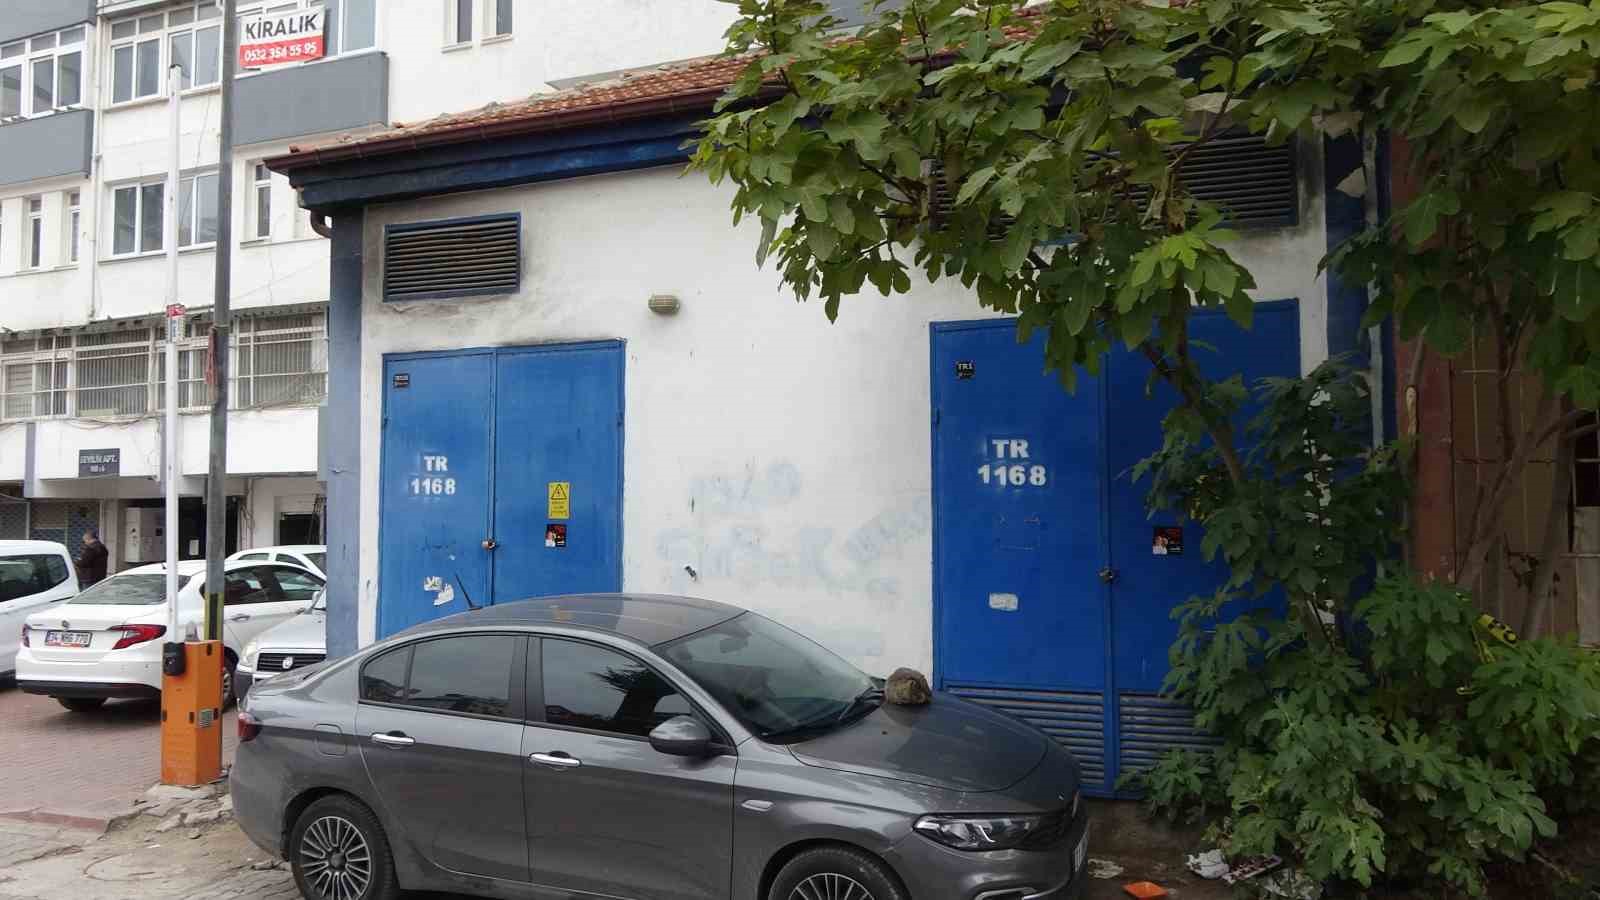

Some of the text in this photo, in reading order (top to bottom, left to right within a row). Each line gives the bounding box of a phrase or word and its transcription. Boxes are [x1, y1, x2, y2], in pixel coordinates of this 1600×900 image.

[246, 13, 318, 39] KİRALIK
[289, 43, 303, 57] 55
[991, 439, 1030, 459] TR
[423, 455, 449, 472] TR
[977, 464, 1047, 489] 1168
[410, 477, 457, 496] 1168
